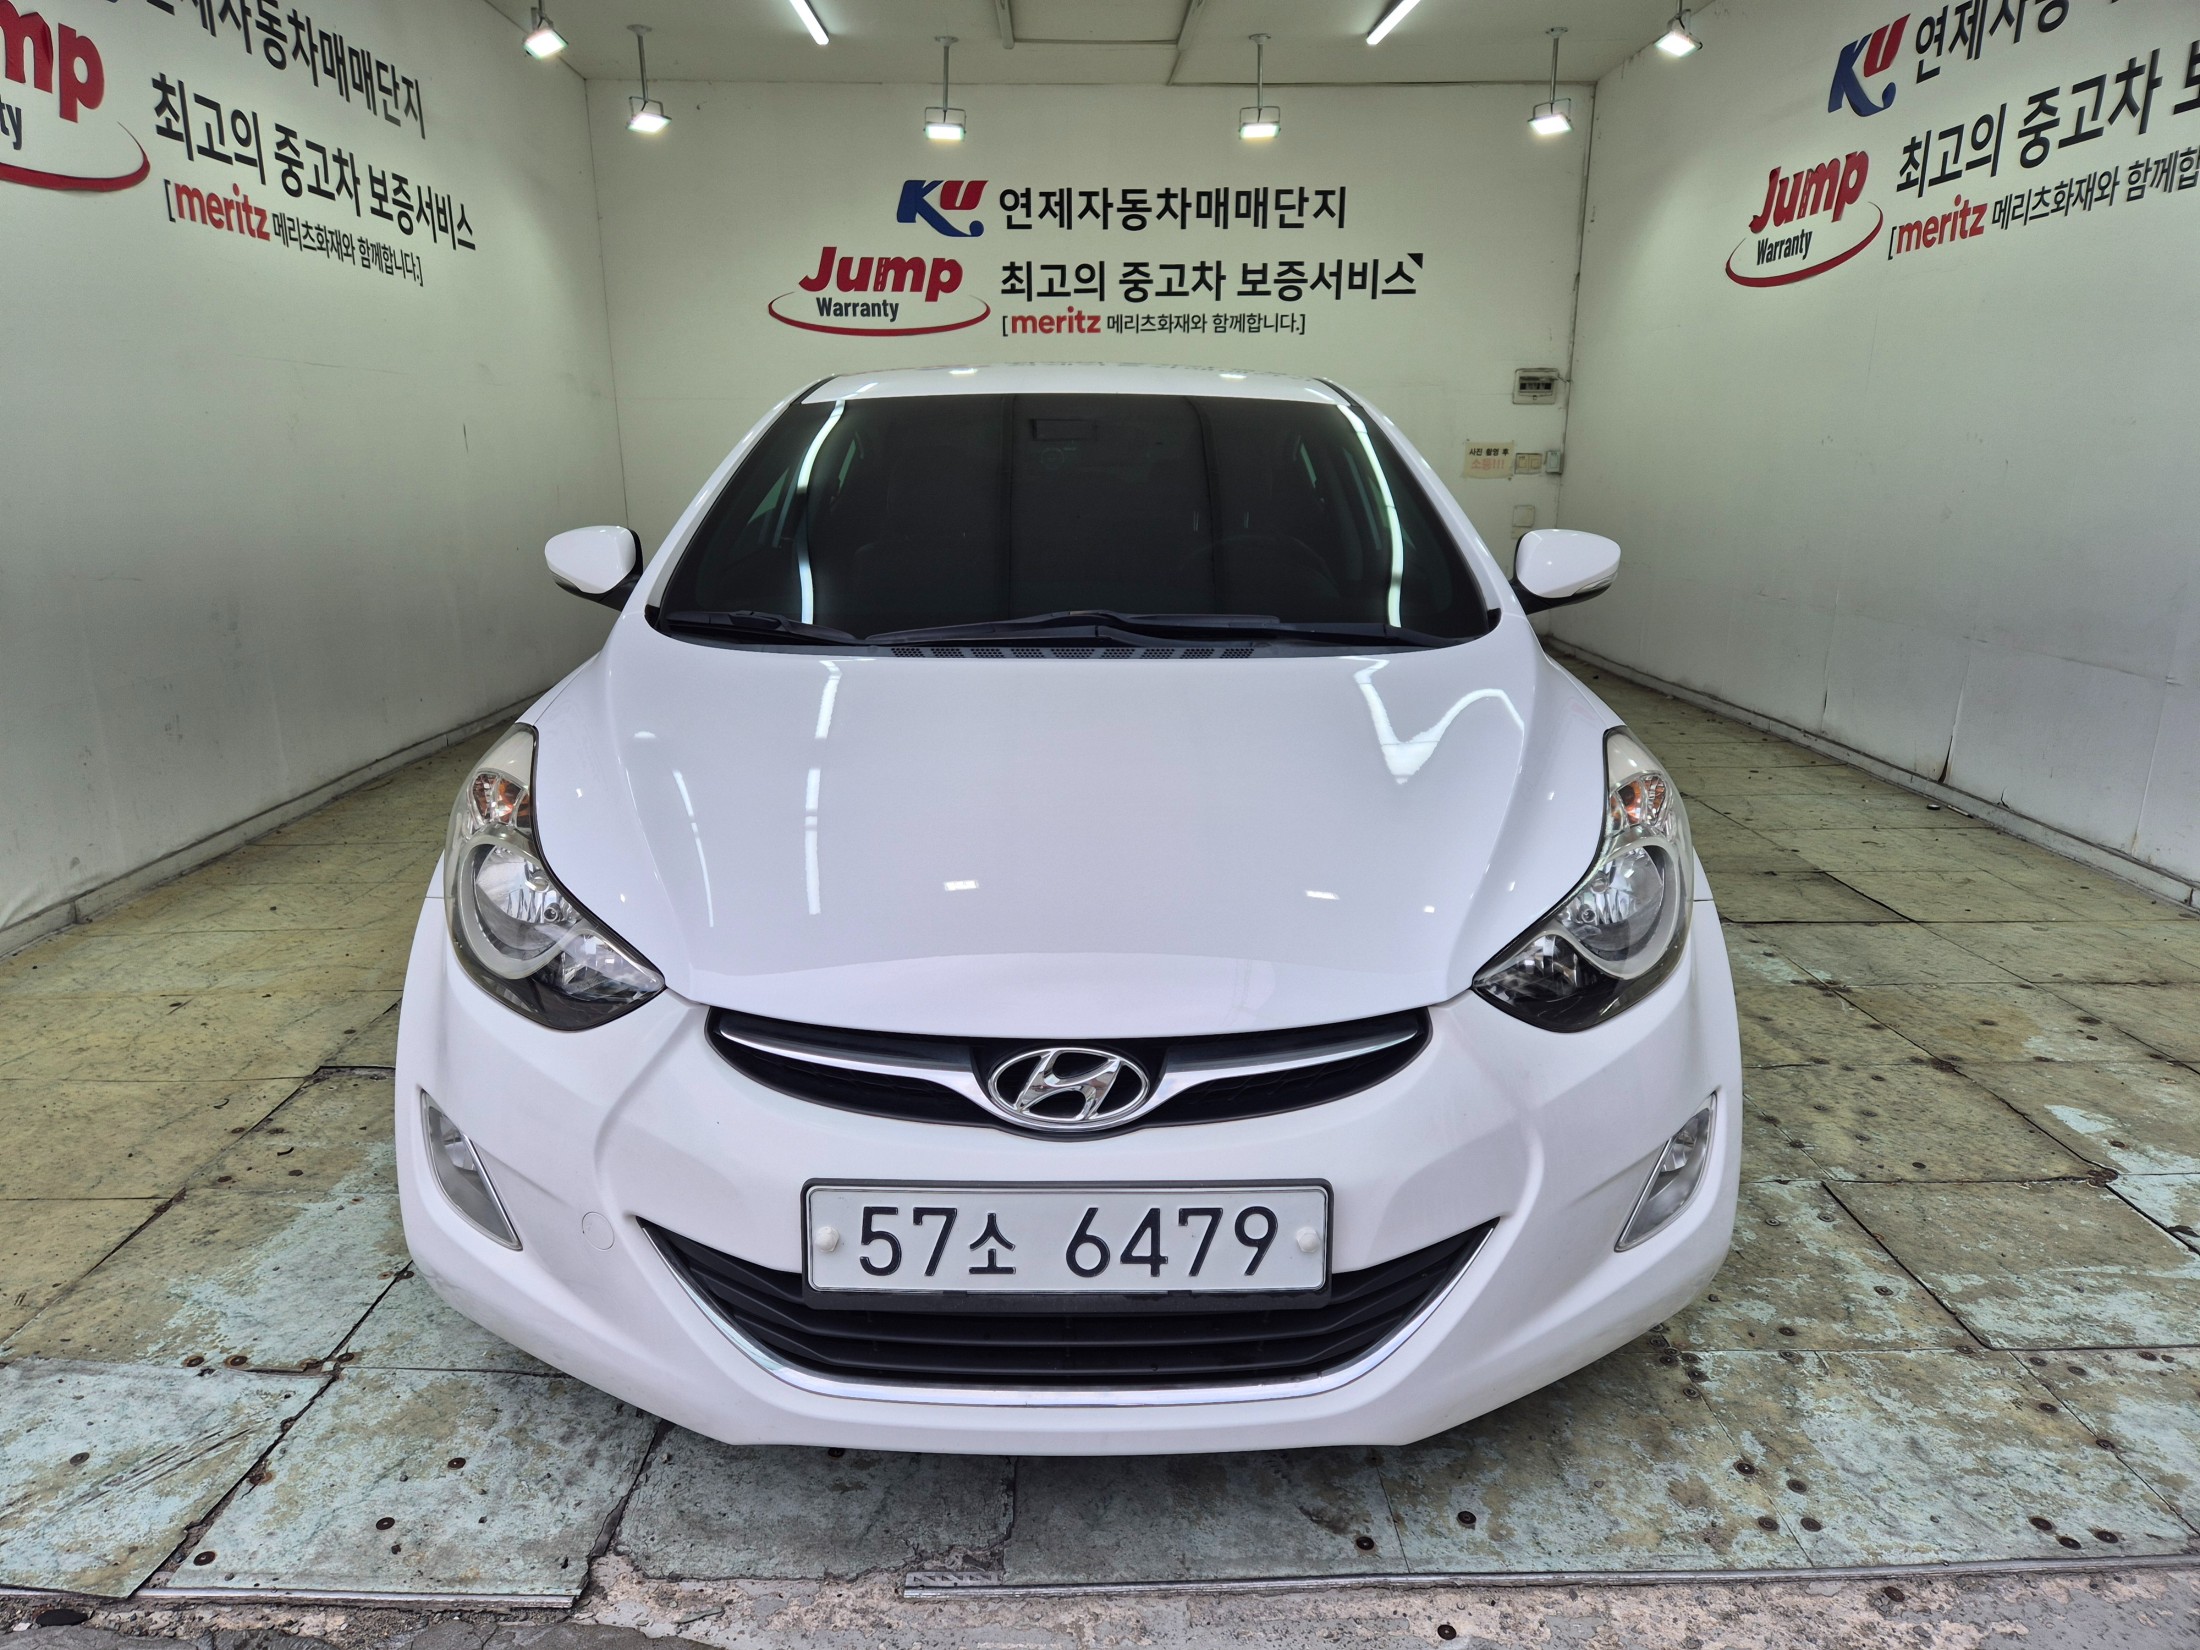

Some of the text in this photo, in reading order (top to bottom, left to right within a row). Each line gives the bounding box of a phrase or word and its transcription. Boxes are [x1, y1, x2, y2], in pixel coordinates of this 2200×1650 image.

[1896, 102, 2007, 198] 최고의
[2017, 47, 2163, 169] 중고차
[151, 72, 477, 251] 최고의 중고차 보증서비스
[1000, 185, 1347, 231] 연제자동차매매단지
[1748, 150, 1870, 234] Jump
[1991, 165, 2120, 230] 메리츠화재와
[272, 211, 357, 265] 메리츠화재와
[1756, 228, 1813, 266] Warranty
[798, 246, 964, 302] Jump
[1000, 258, 1418, 302] 최고의 중고차 보증서비스
[815, 296, 900, 322] Warranty
[1107, 311, 1207, 335] 메리츠화재와
[1469, 448, 1483, 456] 사진
[859, 1205, 1278, 1278] 57소 6479
